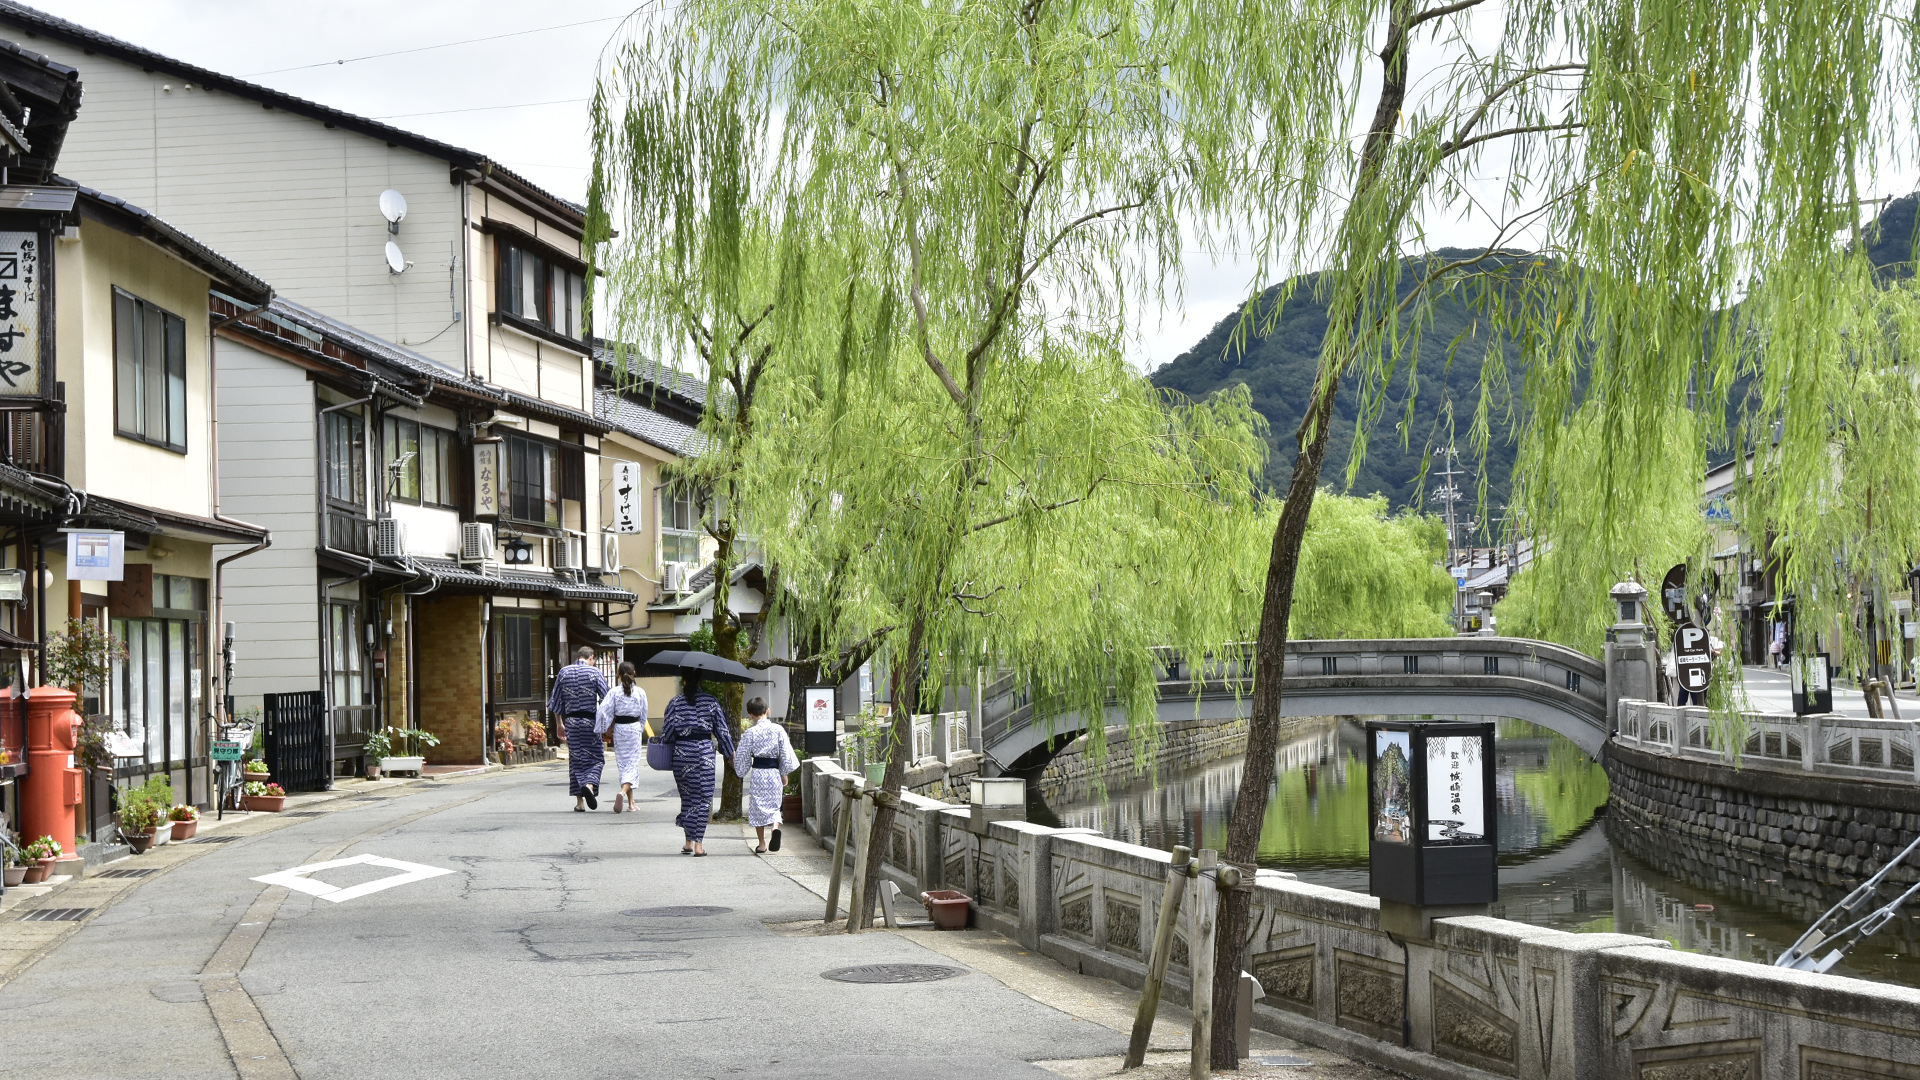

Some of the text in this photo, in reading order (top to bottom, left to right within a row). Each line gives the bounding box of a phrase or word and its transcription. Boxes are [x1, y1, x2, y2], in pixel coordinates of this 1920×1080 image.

[480, 467, 493, 511] なるや
[1682, 628, 1704, 648] P
